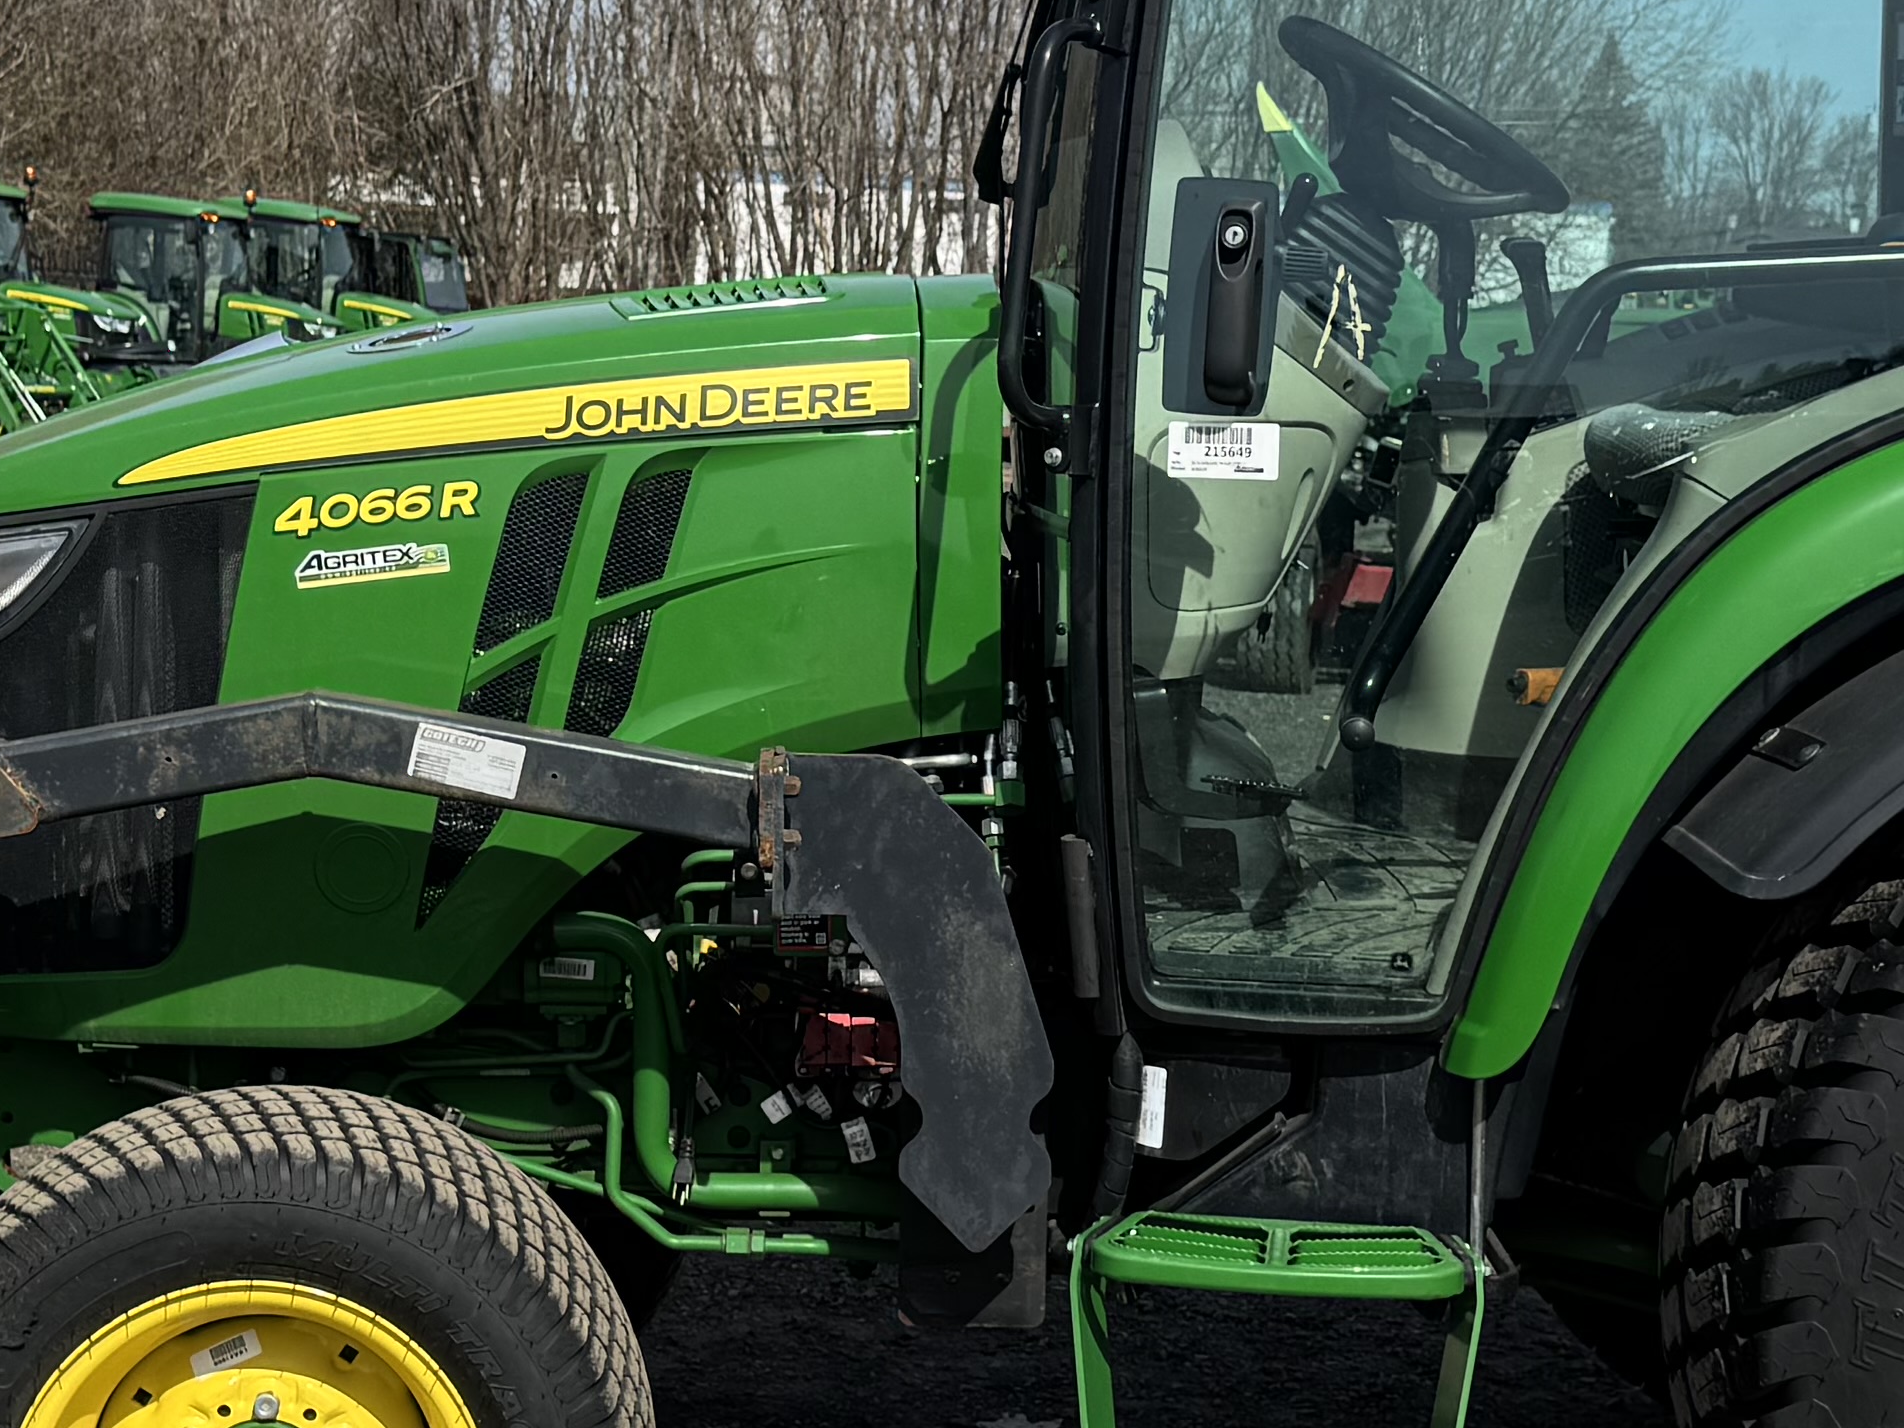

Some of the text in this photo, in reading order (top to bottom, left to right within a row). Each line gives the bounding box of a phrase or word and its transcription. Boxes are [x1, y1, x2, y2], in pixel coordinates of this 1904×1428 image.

[544, 381, 873, 434] JOHN DEERE
[1204, 446, 1252, 458] 215649
[299, 545, 415, 574] AGRITEX
